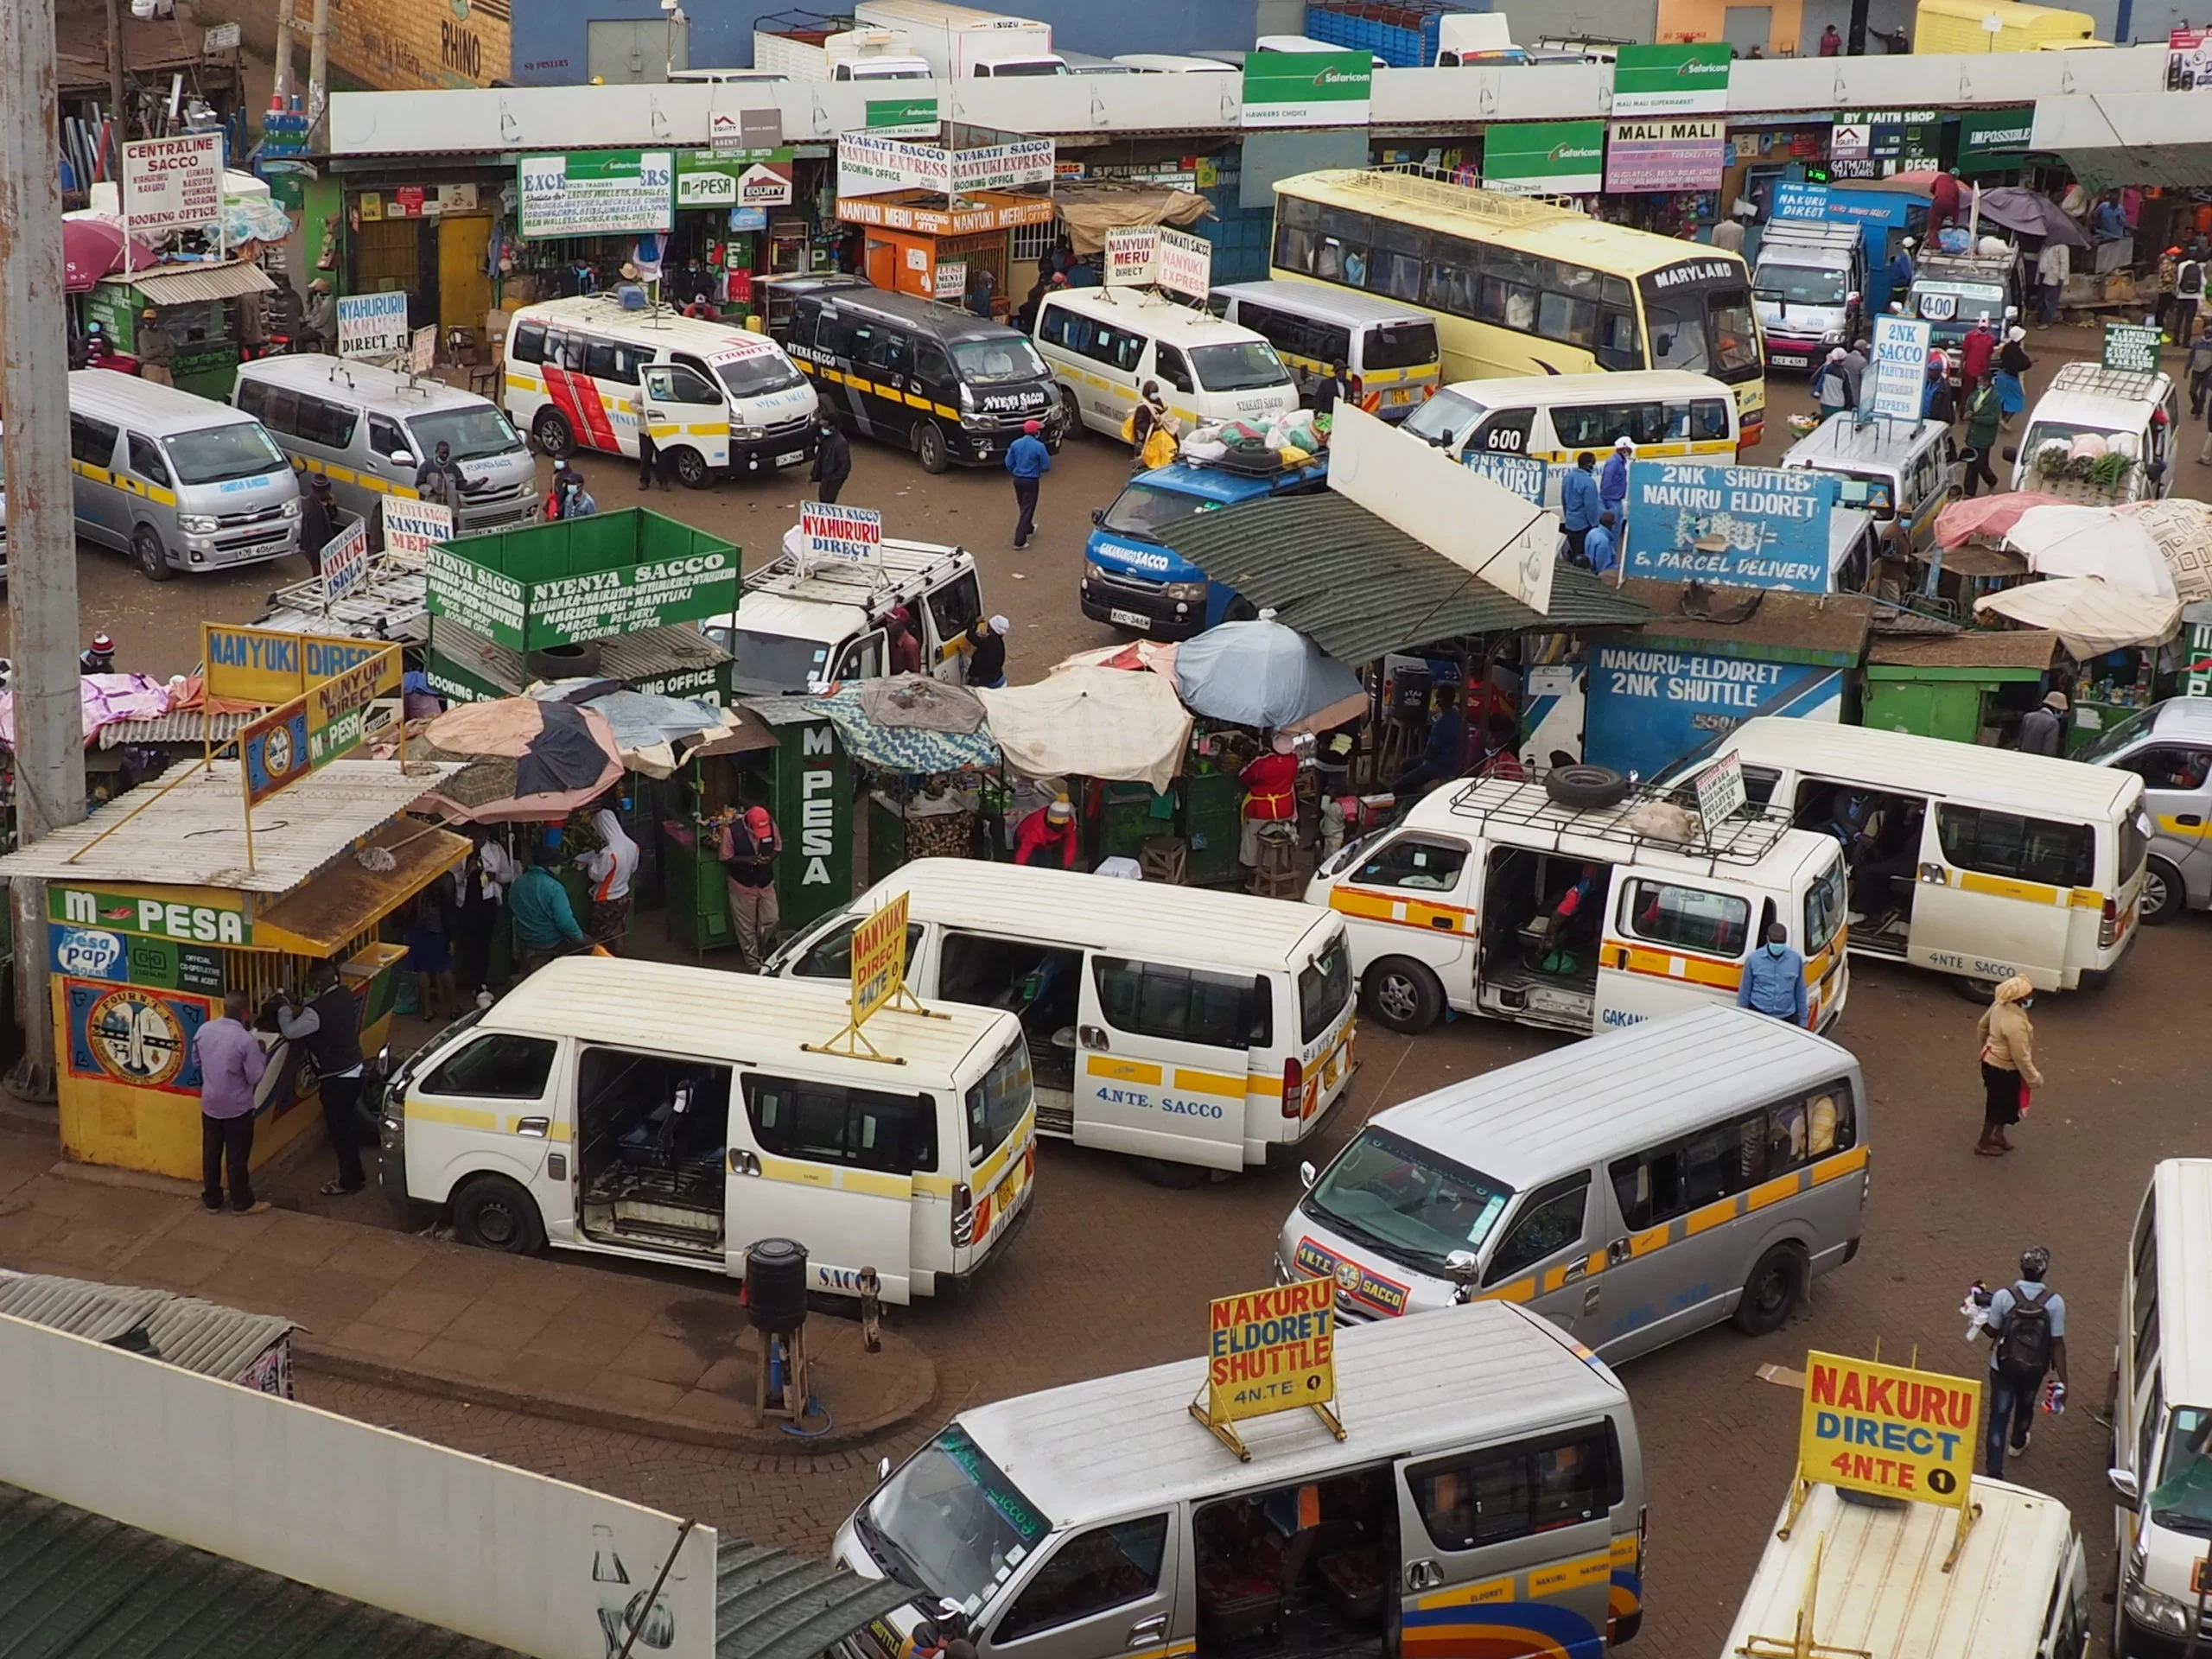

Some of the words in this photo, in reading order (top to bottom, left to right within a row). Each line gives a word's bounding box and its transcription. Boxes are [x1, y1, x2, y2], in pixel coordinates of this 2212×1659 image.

[442, 20, 480, 79] RHINO
[1325, 72, 1370, 82] Safaricom
[1688, 63, 1728, 73] Safaricom
[1843, 113, 1861, 124] BY
[1866, 112, 1901, 124] FAITH
[1904, 111, 1936, 123] SHOP
[1618, 125, 1663, 140] MALI
[1671, 124, 1716, 138] MALI
[128, 139, 213, 158] CENTRALINE
[841, 133, 893, 152] NYAKATI
[899, 144, 945, 161] SACCO
[955, 149, 1003, 162] NYAKATI
[1010, 141, 1051, 155] SACCO
[1559, 149, 1601, 158] Safaricom
[148, 156, 198, 172] SACCO
[840, 144, 883, 166] NANYUKI
[889, 154, 948, 178] EXPRESS
[842, 162, 873, 176] BOOKING
[875, 169, 901, 181] OFFICE
[954, 160, 1001, 178] NANYUKI
[1004, 152, 1052, 171] EXPRESS
[1092, 165, 1160, 178] SPRINGS
[701, 178, 731, 194] PESA
[744, 187, 785, 196] EQUITY
[954, 178, 986, 191] BOOKING
[988, 175, 1014, 186] OFFICE
[1779, 194, 1827, 207] NAKURU
[128, 211, 175, 226] BOOKING
[179, 206, 217, 219] OFFICE
[839, 201, 880, 223] NANYUKI
[885, 208, 912, 228] MERU
[954, 211, 994, 232] NANYUKI
[999, 207, 1026, 226] MERU
[1783, 206, 1825, 218] DIRECT
[1109, 238, 1154, 251] NANYUKI
[1160, 232, 1190, 252] NYAKATI
[1115, 251, 1149, 265] MERU
[1164, 251, 1204, 276] NANYUKI
[1116, 267, 1143, 276] DIRECT
[1164, 269, 1206, 292] EXPRESS
[1654, 263, 1732, 289] MARYLAND
[339, 295, 404, 321] NYAHURURU
[1923, 296, 1951, 316] 400
[343, 334, 388, 353] DIRECT
[1888, 324, 1916, 343] 2NK
[715, 345, 773, 361] TRINITY
[1878, 343, 1923, 363] SACCO
[1488, 429, 1521, 450] 600
[1471, 454, 1500, 467] 2NK
[1503, 458, 1541, 472] SACCO
[1662, 466, 1707, 485] 2NK
[1725, 470, 1806, 493] SHUTTLE
[1643, 485, 1721, 510] NAKURU
[1731, 491, 1818, 518] ELDORET
[388, 514, 449, 539] NANYUKI
[847, 508, 879, 523] SACCO
[803, 515, 880, 544] NYAHURURU
[392, 532, 429, 553] MER
[812, 537, 871, 557] DIRECT
[1135, 550, 1169, 570] SACCO
[1635, 550, 1651, 566] &
[1658, 552, 1730, 572] PARCEL
[1737, 558, 1821, 582] DELIVERY
[427, 546, 473, 581] NYENYA
[477, 568, 521, 599] SACCO
[533, 571, 620, 601] NYENYA
[634, 554, 725, 582] SACCO
[634, 588, 692, 607] NANYUKI
[556, 617, 599, 634] PARCEL
[610, 607, 657, 624] DELIVERY
[570, 624, 620, 643] BOOKING
[628, 616, 661, 632] OFFICE
[210, 632, 299, 672] NANYUKI
[307, 643, 383, 677] DIRE
[319, 657, 387, 709] NANYUKI
[427, 671, 473, 701] BOOKING
[668, 670, 716, 693] OFFICE
[1611, 672, 1658, 697] 2NK
[1667, 677, 1759, 708] SHUTTLE
[327, 680, 378, 719] DIRECT
[329, 712, 360, 749] PESA
[138, 899, 243, 944] PESA
[855, 899, 906, 964] NANYUKI
[67, 947, 116, 969] pap!
[186, 955, 212, 965] OFFICIAL
[857, 936, 900, 987] DIRECT
[1929, 951, 1963, 969] 4NTE
[1975, 960, 2016, 977] SACCO
[1161, 1097, 1224, 1119] SACCO
[1363, 1280, 1402, 1307] SACCO
[1213, 1281, 1331, 1331] NAKURU
[1213, 1310, 1330, 1357] ELDORET
[1213, 1336, 1330, 1386] SHUTTLE
[1811, 1363, 1973, 1429] NAKURU
[1816, 1412, 1961, 1462] DIRECT
[1536, 1573, 1567, 1586] NAKURU
[1470, 1588, 1503, 1603] ELDORET
